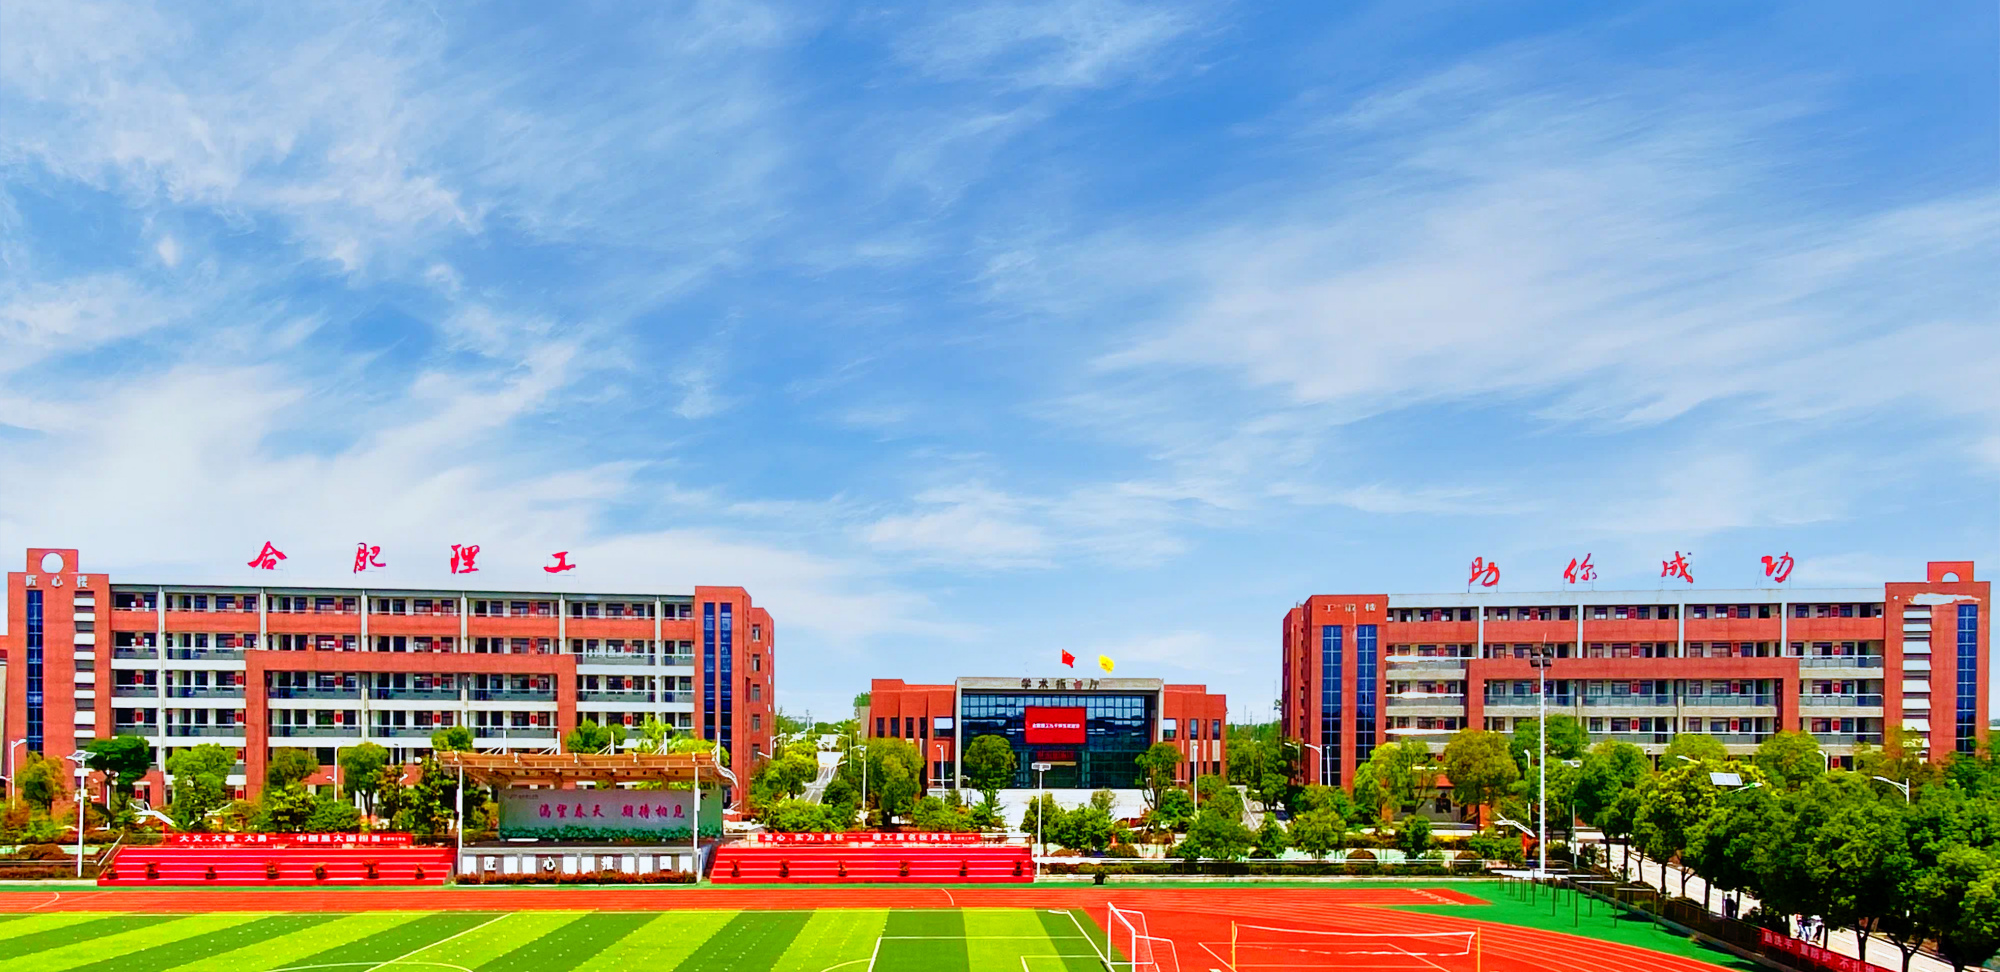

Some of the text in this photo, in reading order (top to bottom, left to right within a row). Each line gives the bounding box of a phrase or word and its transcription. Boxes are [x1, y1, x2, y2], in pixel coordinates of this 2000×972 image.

[247, 541, 576, 574] 合肥理工
[1469, 551, 1795, 588] 助你成功
